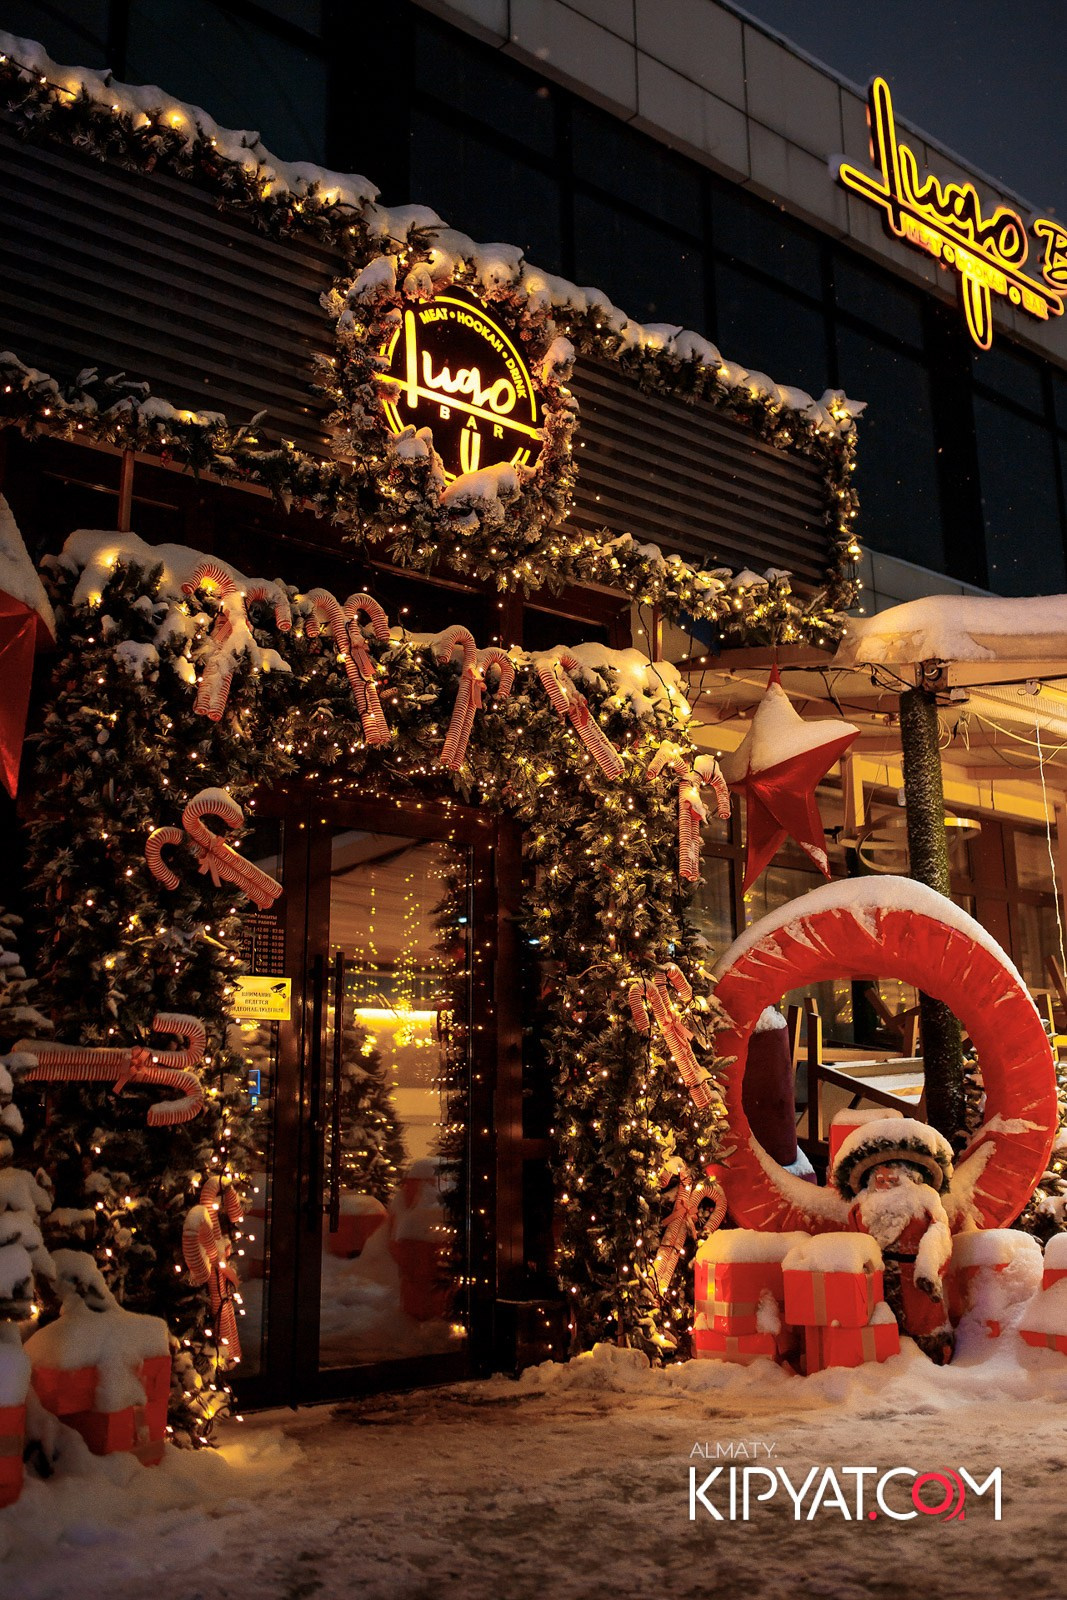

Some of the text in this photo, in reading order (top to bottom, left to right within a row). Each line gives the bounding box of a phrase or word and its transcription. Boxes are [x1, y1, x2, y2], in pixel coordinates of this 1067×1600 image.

[1021, 287, 1049, 320] BAR
[418, 307, 528, 399] MEAT HOOKAH DRINK
[231, 1005, 285, 1013] ИДЕОНАБЛЮДЕНИЕ
